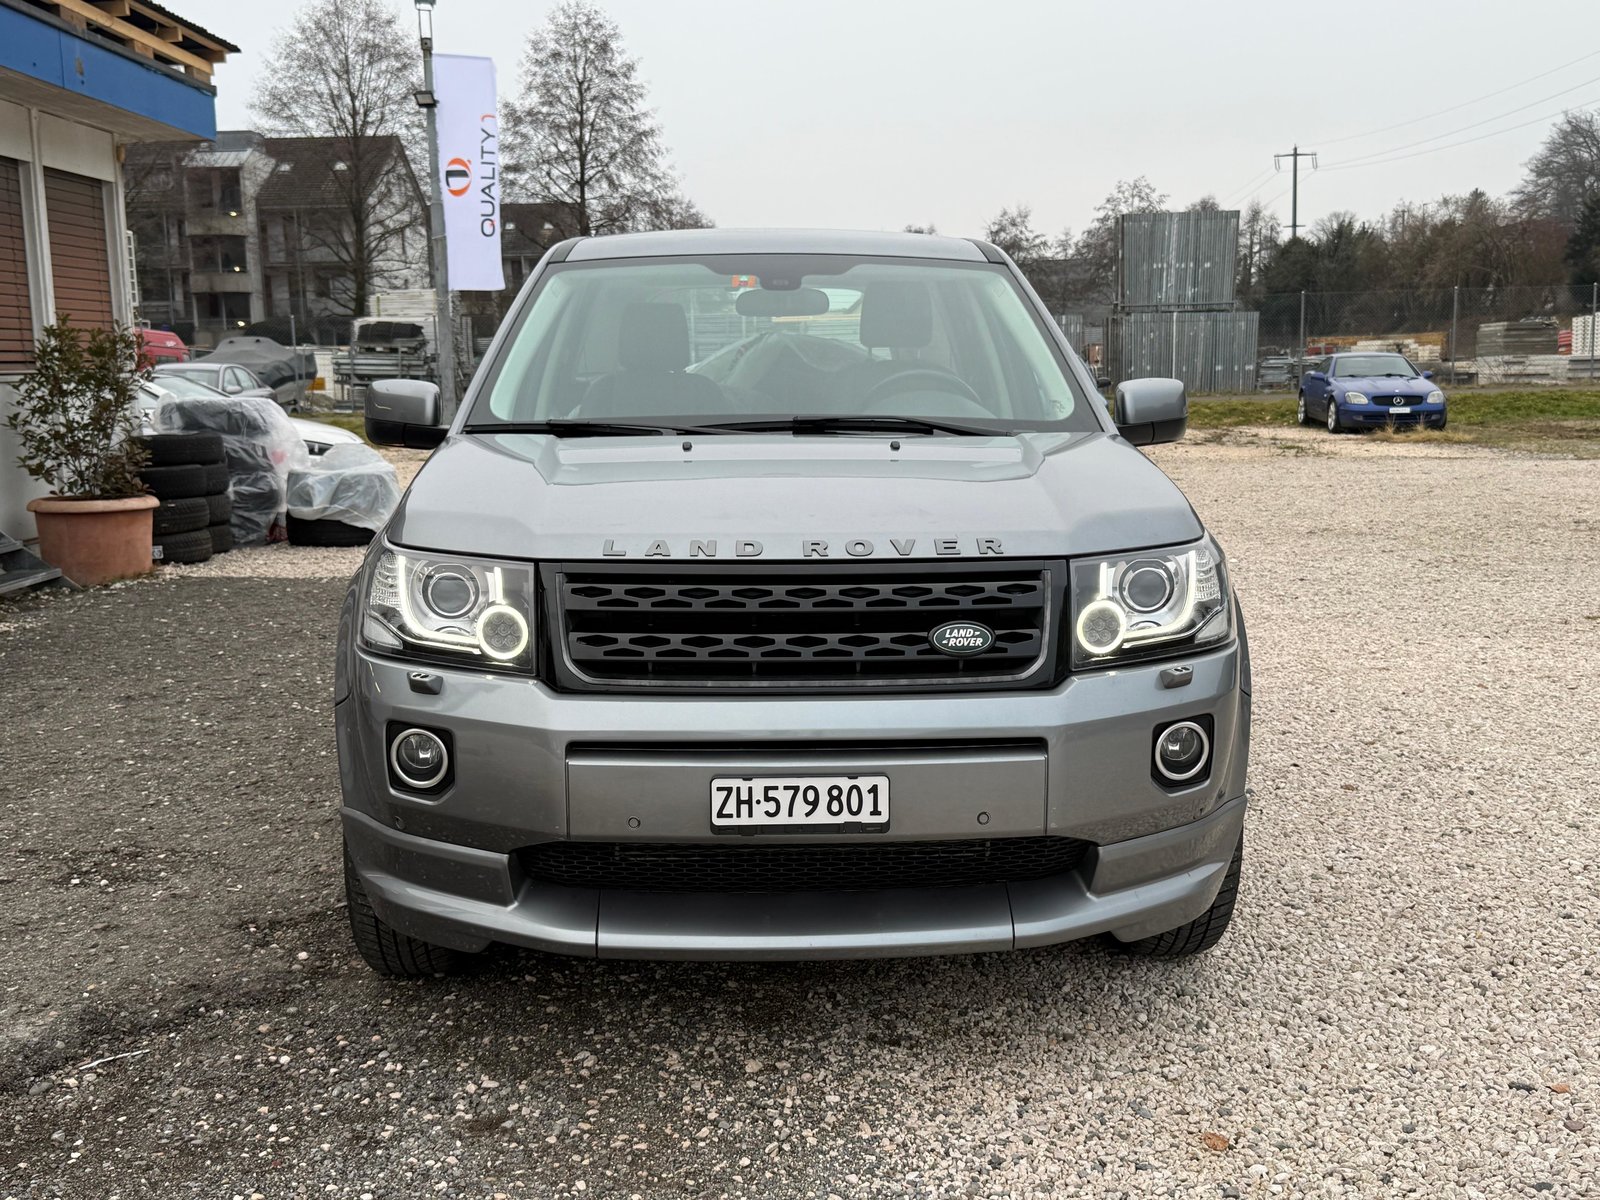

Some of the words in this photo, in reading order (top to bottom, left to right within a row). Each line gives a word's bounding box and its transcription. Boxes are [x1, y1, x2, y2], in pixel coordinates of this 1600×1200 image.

[602, 539, 764, 557] LAND
[802, 537, 1004, 557] ROVER
[945, 628, 974, 638] LAND
[948, 637, 983, 647] ROVER
